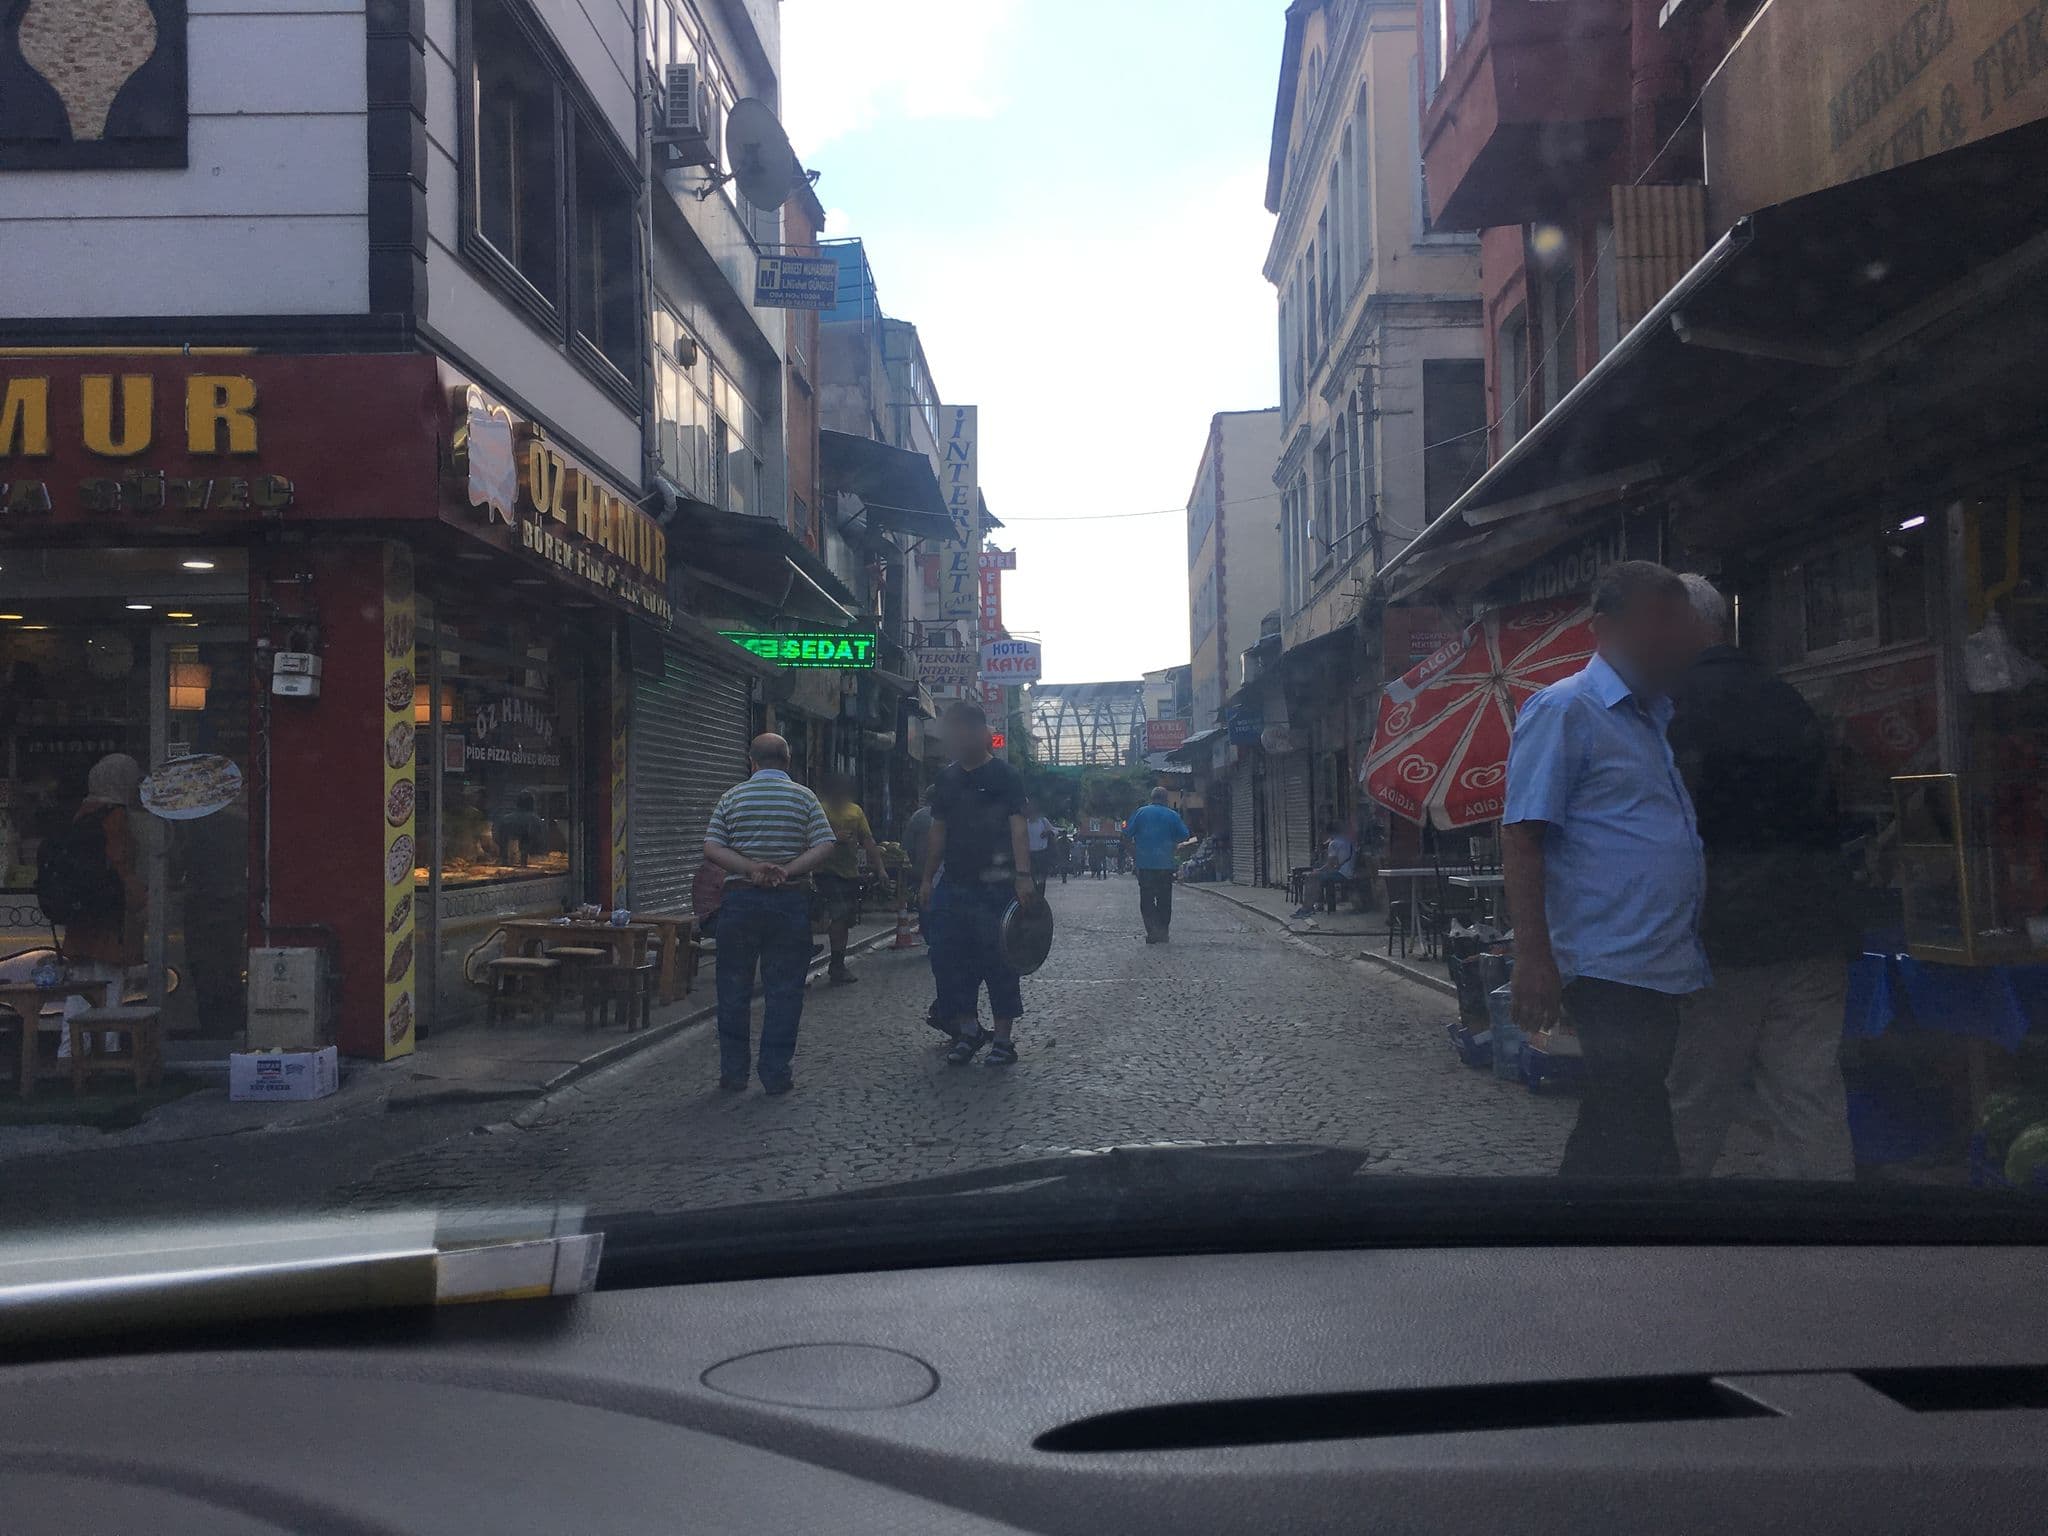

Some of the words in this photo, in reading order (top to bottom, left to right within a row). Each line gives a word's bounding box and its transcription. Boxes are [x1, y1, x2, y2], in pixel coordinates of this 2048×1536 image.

[576, 470, 668, 584] HAMUR
[782, 639, 870, 660] SEDAT
[993, 642, 1030, 656] HOTEL
[1419, 641, 1464, 678] ALGID
[986, 656, 1037, 672] KAYA
[502, 696, 554, 746] HAMUR
[466, 743, 487, 761] PİDE
[487, 744, 511, 763] PİZZA
